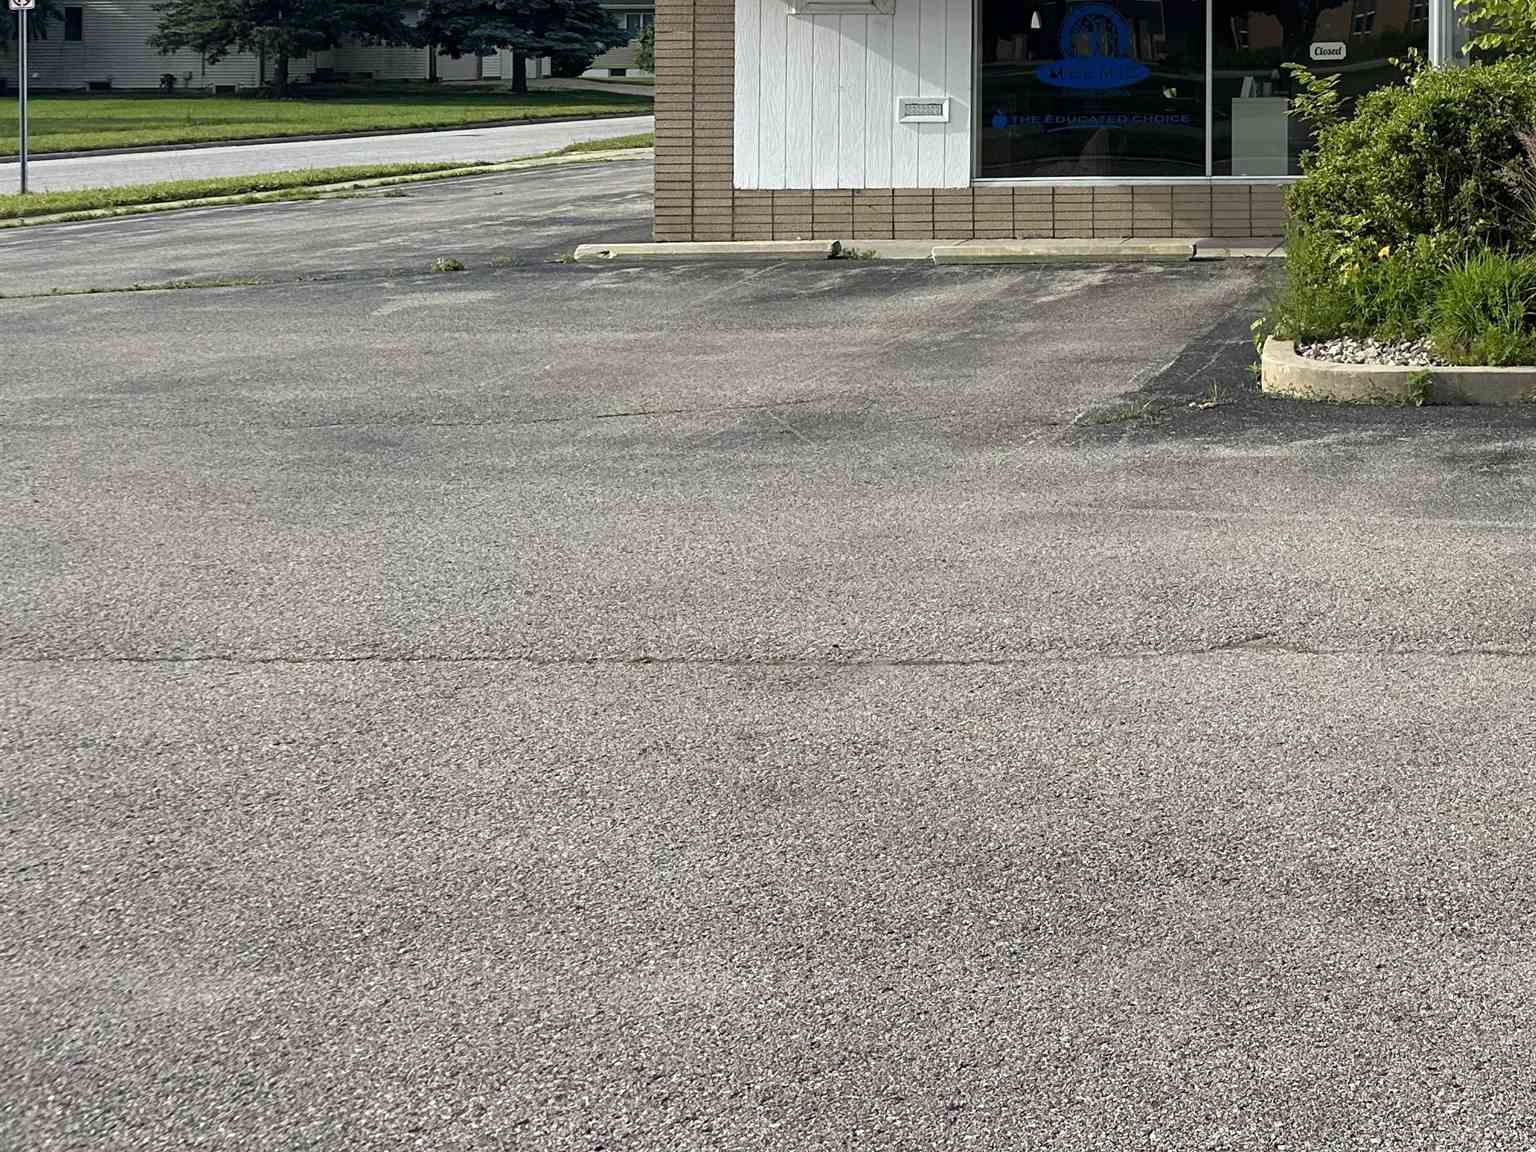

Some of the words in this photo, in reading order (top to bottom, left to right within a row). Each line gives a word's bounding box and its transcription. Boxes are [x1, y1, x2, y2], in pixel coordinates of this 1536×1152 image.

[1314, 47, 1343, 57] Closed
[1045, 114, 1128, 125] EDUCATED
[1130, 114, 1192, 125] CHOICE
